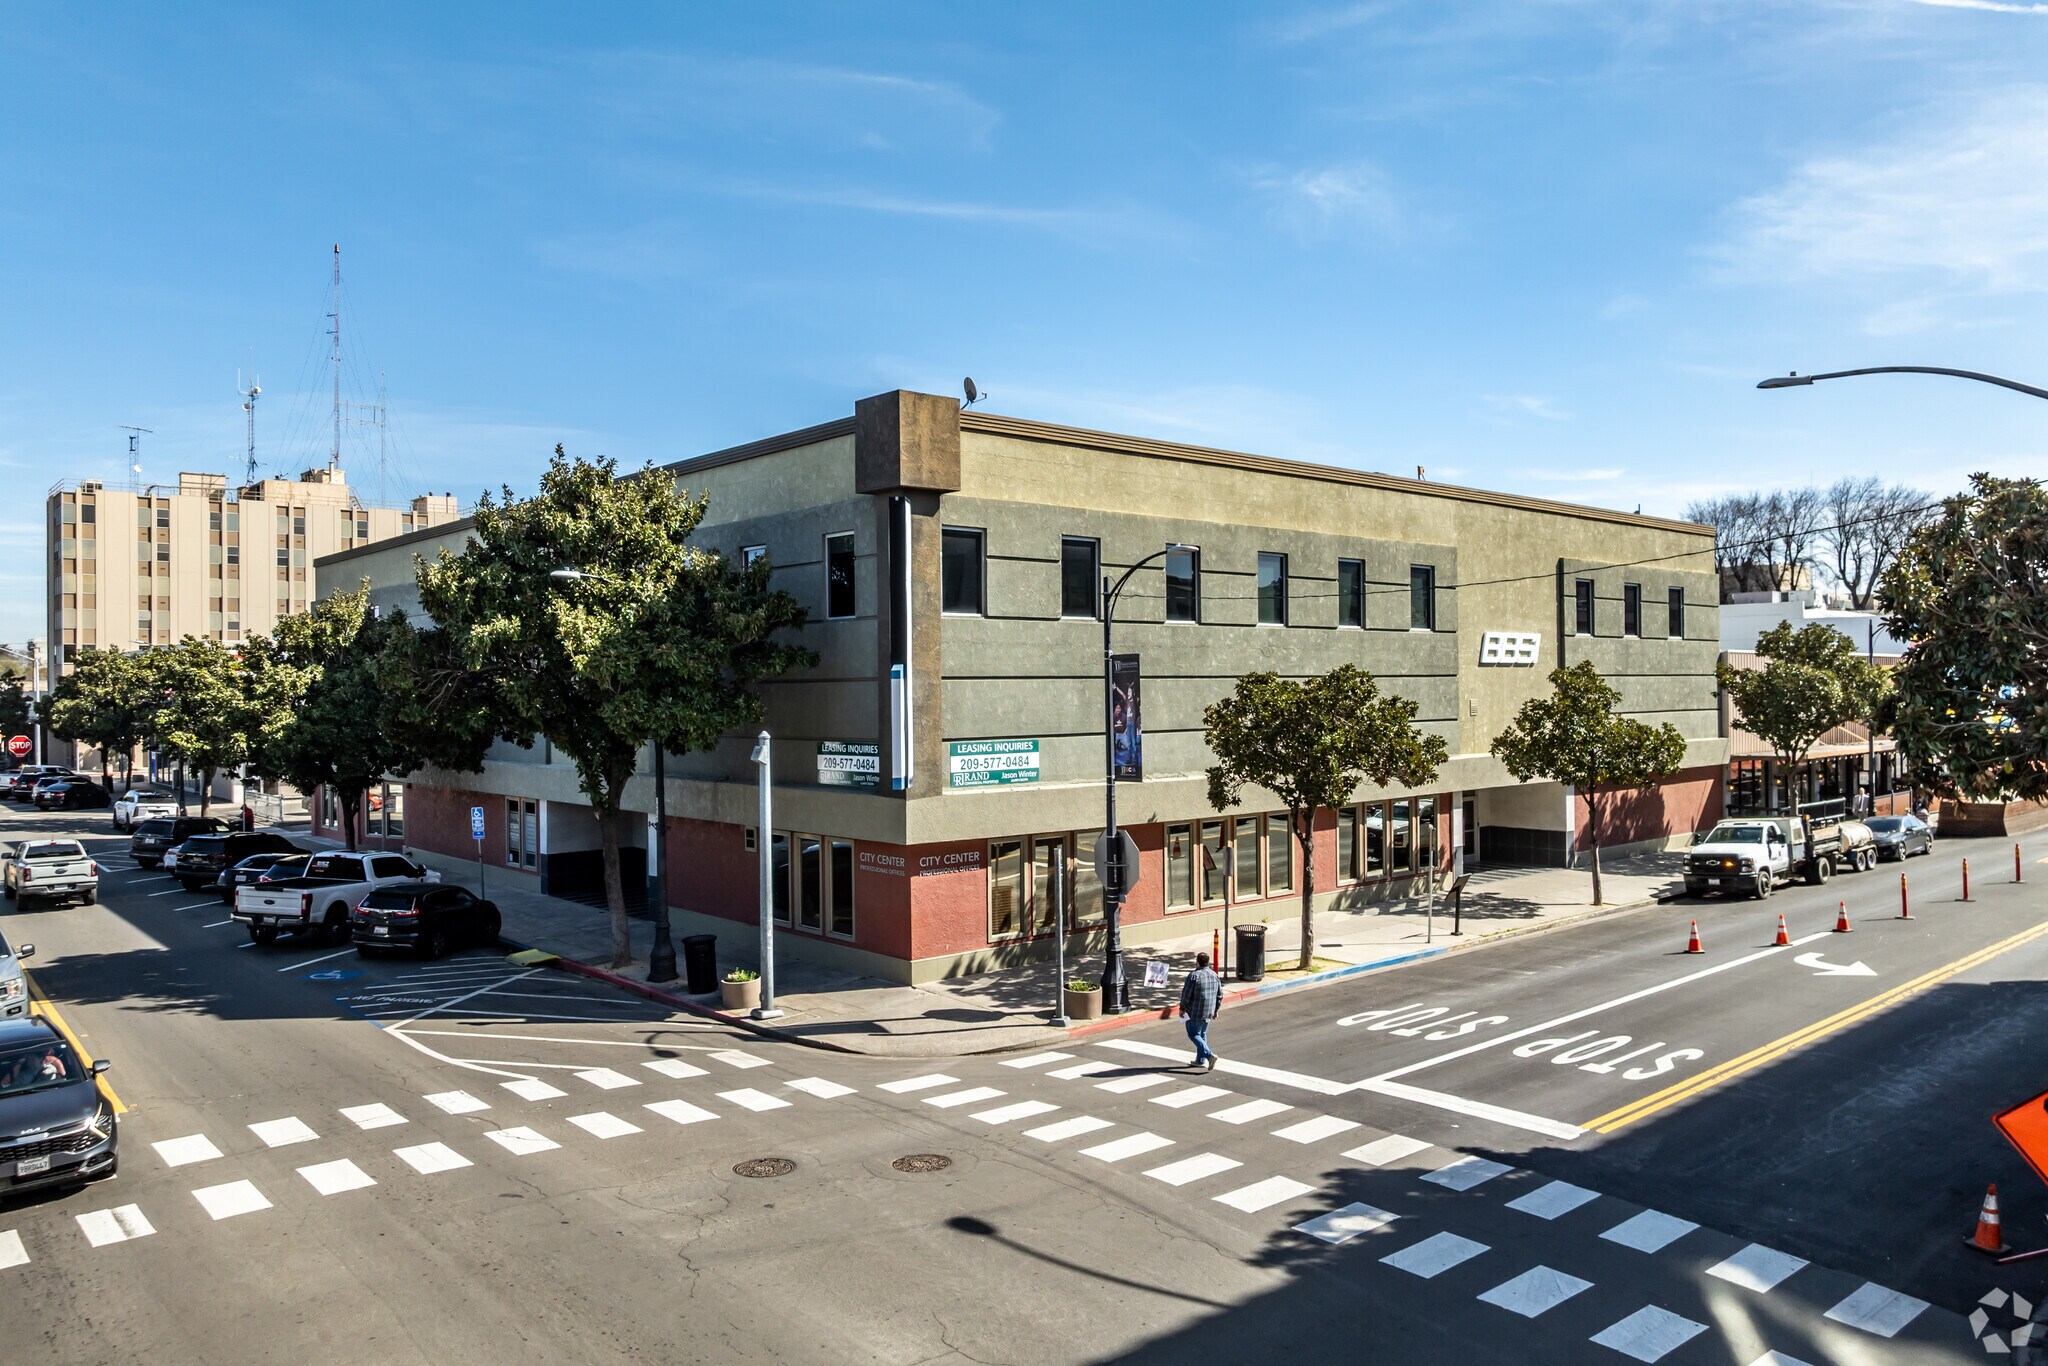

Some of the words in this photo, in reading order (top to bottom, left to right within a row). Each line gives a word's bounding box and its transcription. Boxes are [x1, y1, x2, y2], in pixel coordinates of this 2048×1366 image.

[11, 741, 31, 749] STOP
[821, 743, 847, 753] LEASING
[847, 744, 879, 754] INQUIRIES
[957, 743, 992, 754] LEASING
[994, 741, 1034, 752] INQUIRIES
[823, 757, 876, 771] 209-577-0484
[960, 755, 1030, 771] 209-577-0484
[826, 771, 845, 780] RAND
[964, 771, 990, 781] RAND
[1018, 770, 1037, 778] Winter
[860, 852, 875, 863] CITY
[877, 854, 905, 867] CENTER
[919, 855, 941, 867] CITY
[943, 851, 980, 865] CENTER
[860, 864, 888, 874] PROFESSIONAL
[888, 868, 905, 877] OFFICES
[919, 866, 959, 877] PROFESSIONAL
[959, 863, 980, 872] OFFICES
[1336, 1002, 1509, 1041] STOP
[1512, 1030, 1704, 1080] STOP
